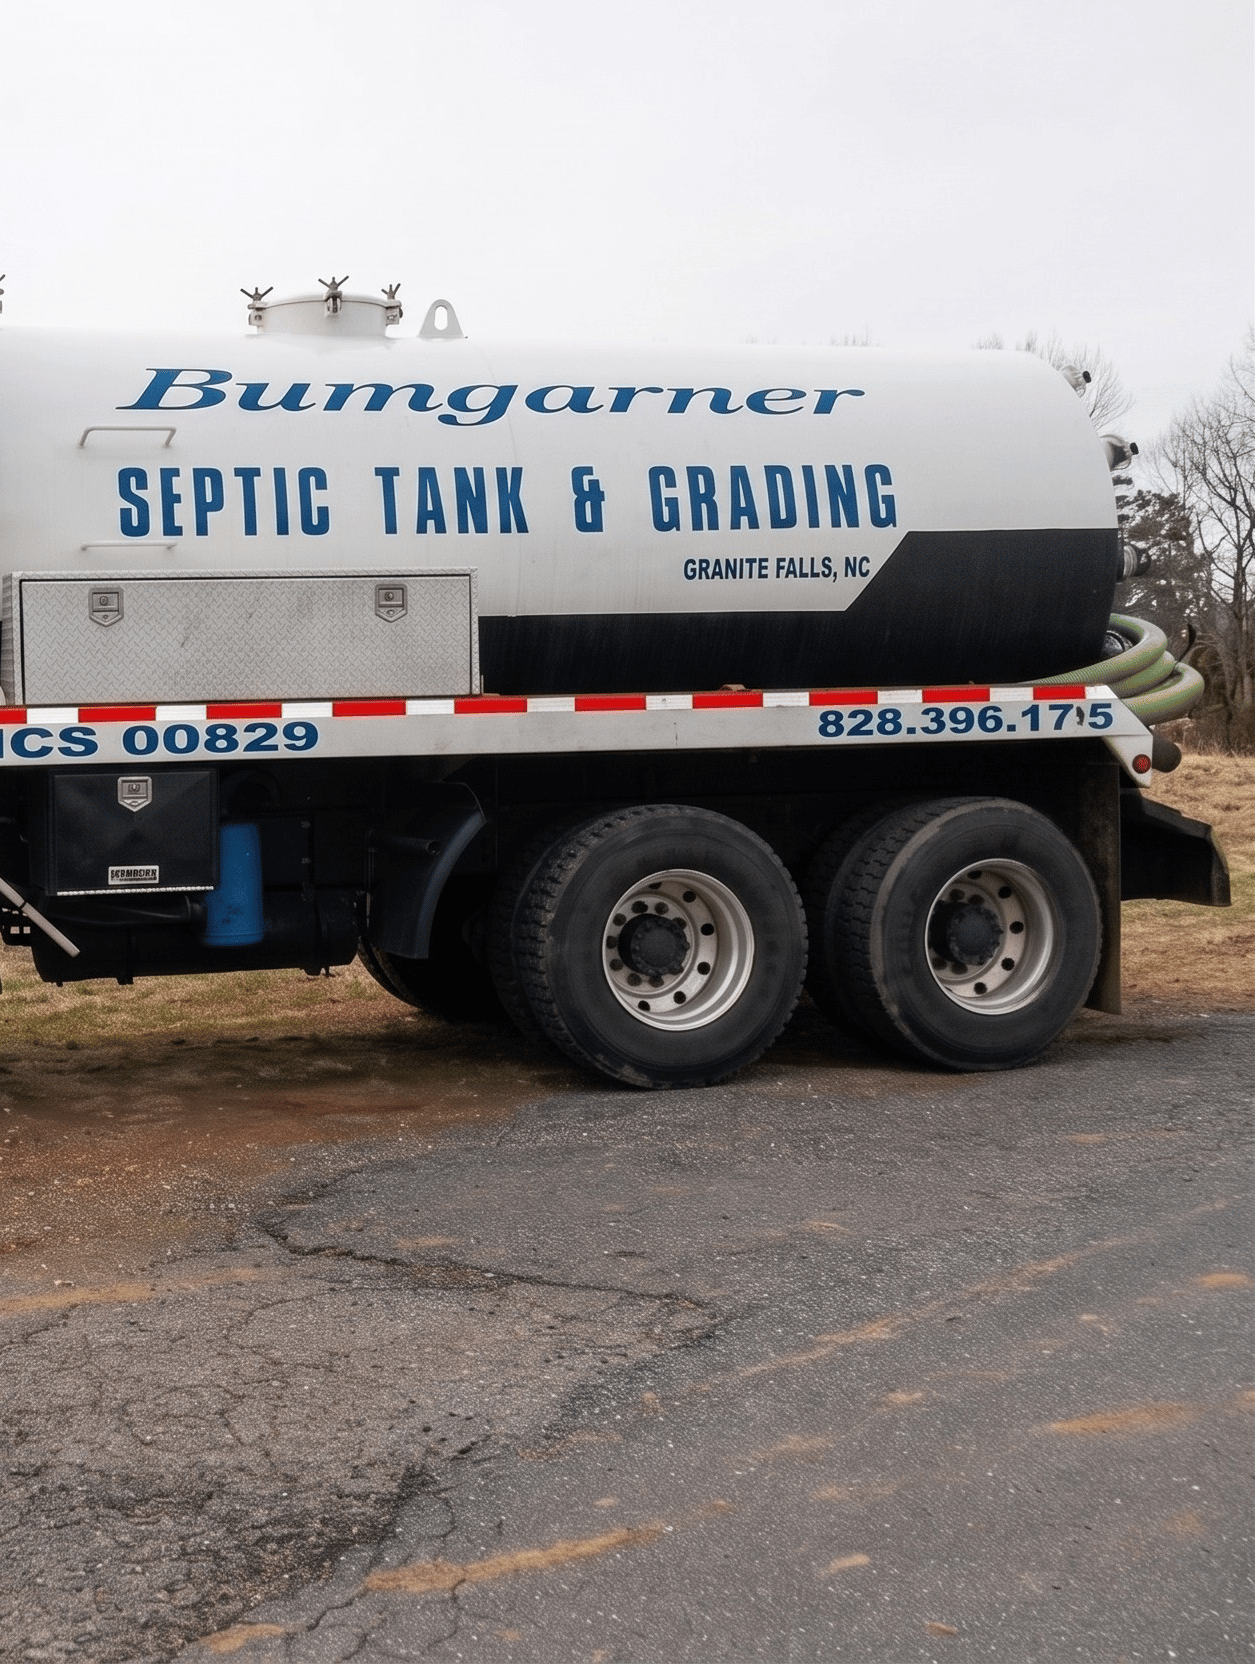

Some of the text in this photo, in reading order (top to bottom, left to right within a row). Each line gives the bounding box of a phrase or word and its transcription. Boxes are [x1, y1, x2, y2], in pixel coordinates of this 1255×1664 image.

[115, 368, 866, 427] Bumgarner
[117, 463, 897, 538] SEPTIC TANK & GRADING
[683, 555, 871, 583] GRANITE FALLS, NC
[122, 721, 319, 756] 00829
